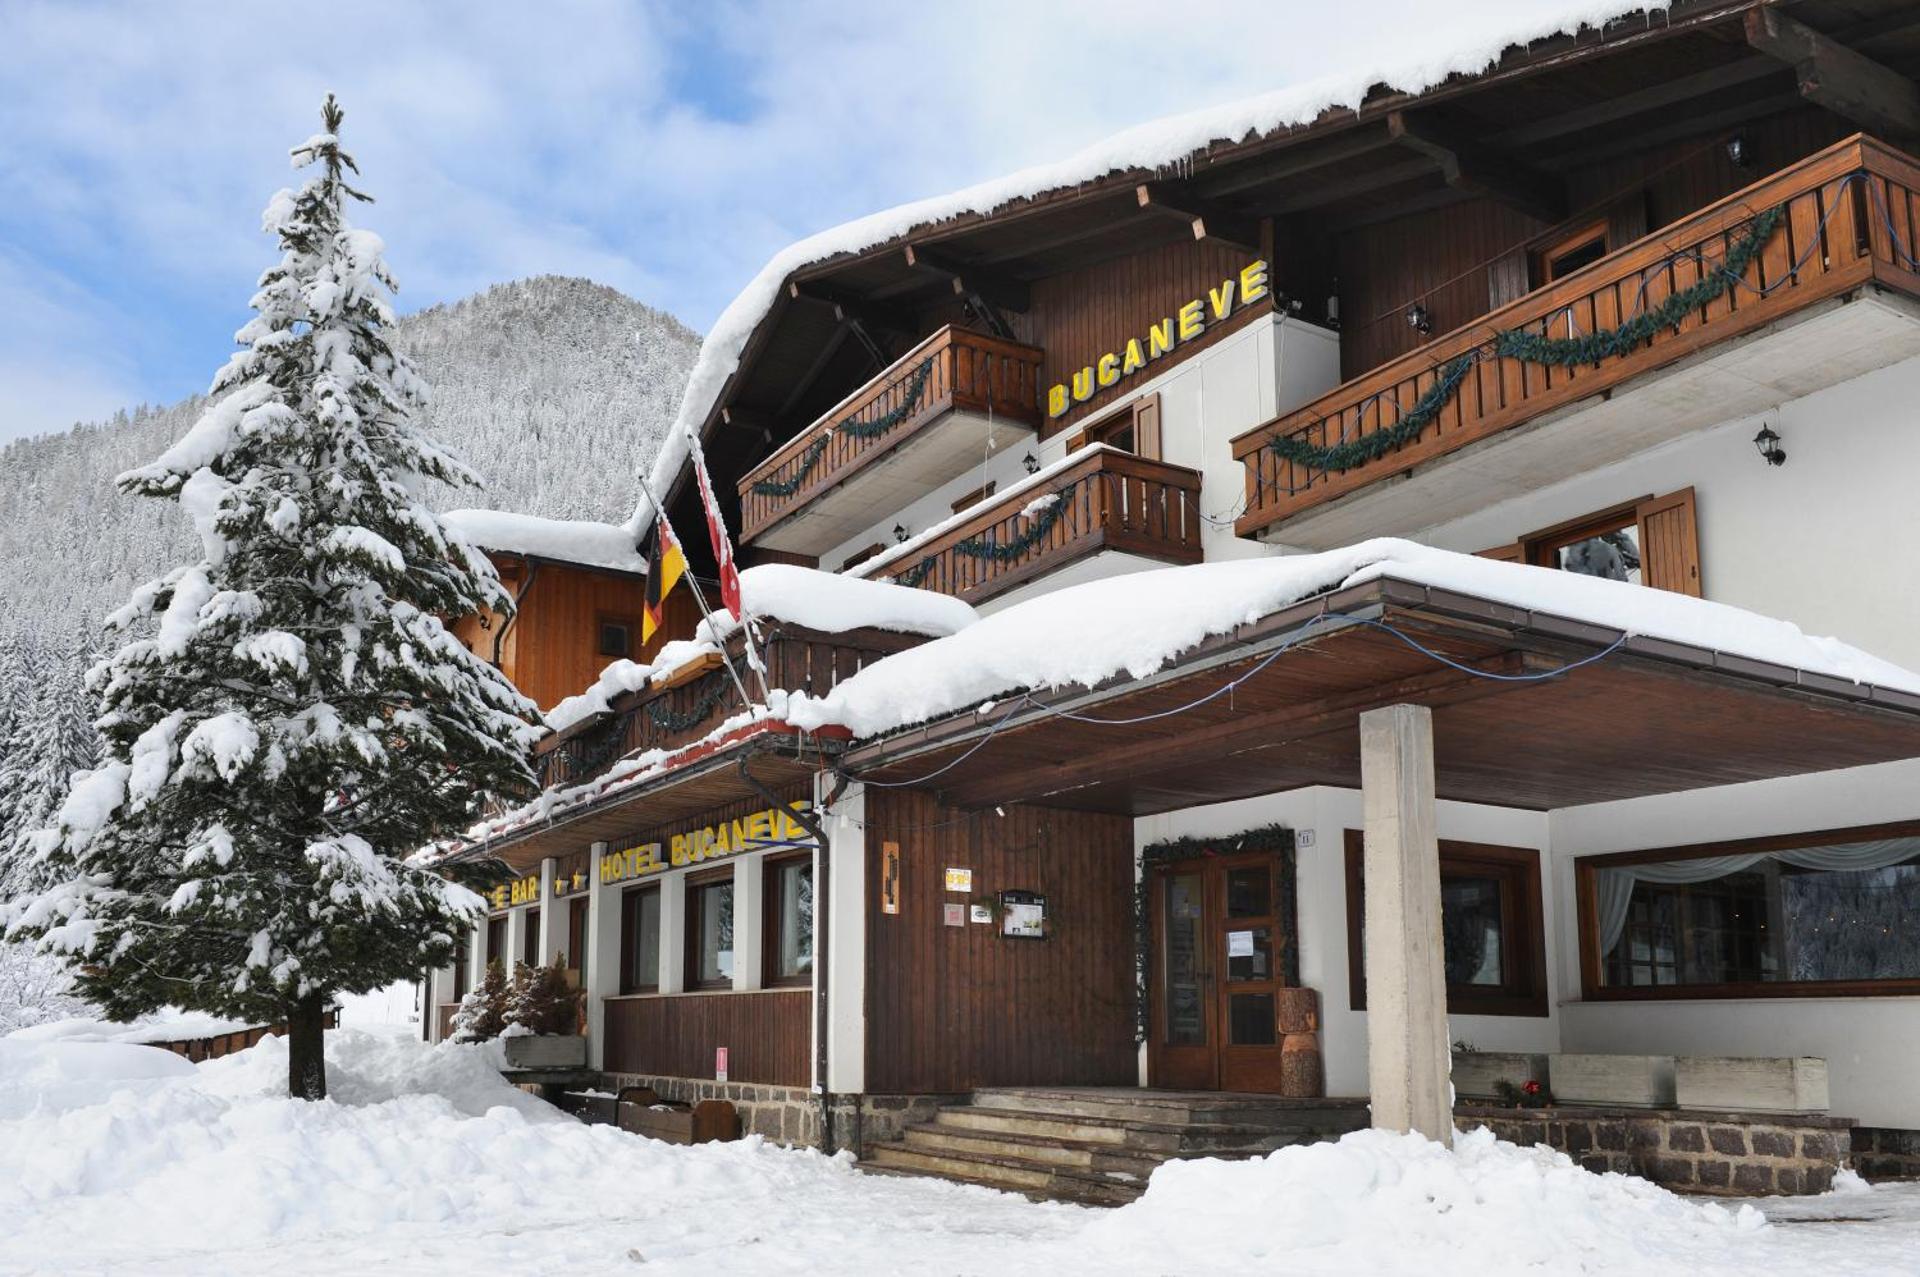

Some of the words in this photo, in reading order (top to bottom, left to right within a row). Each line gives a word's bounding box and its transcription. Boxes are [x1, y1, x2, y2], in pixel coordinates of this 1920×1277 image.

[1048, 259, 1268, 418] BUCANEVE
[600, 842, 667, 883] HOTEL
[671, 800, 811, 867] BUCANEVE
[511, 875, 538, 905] BAR
